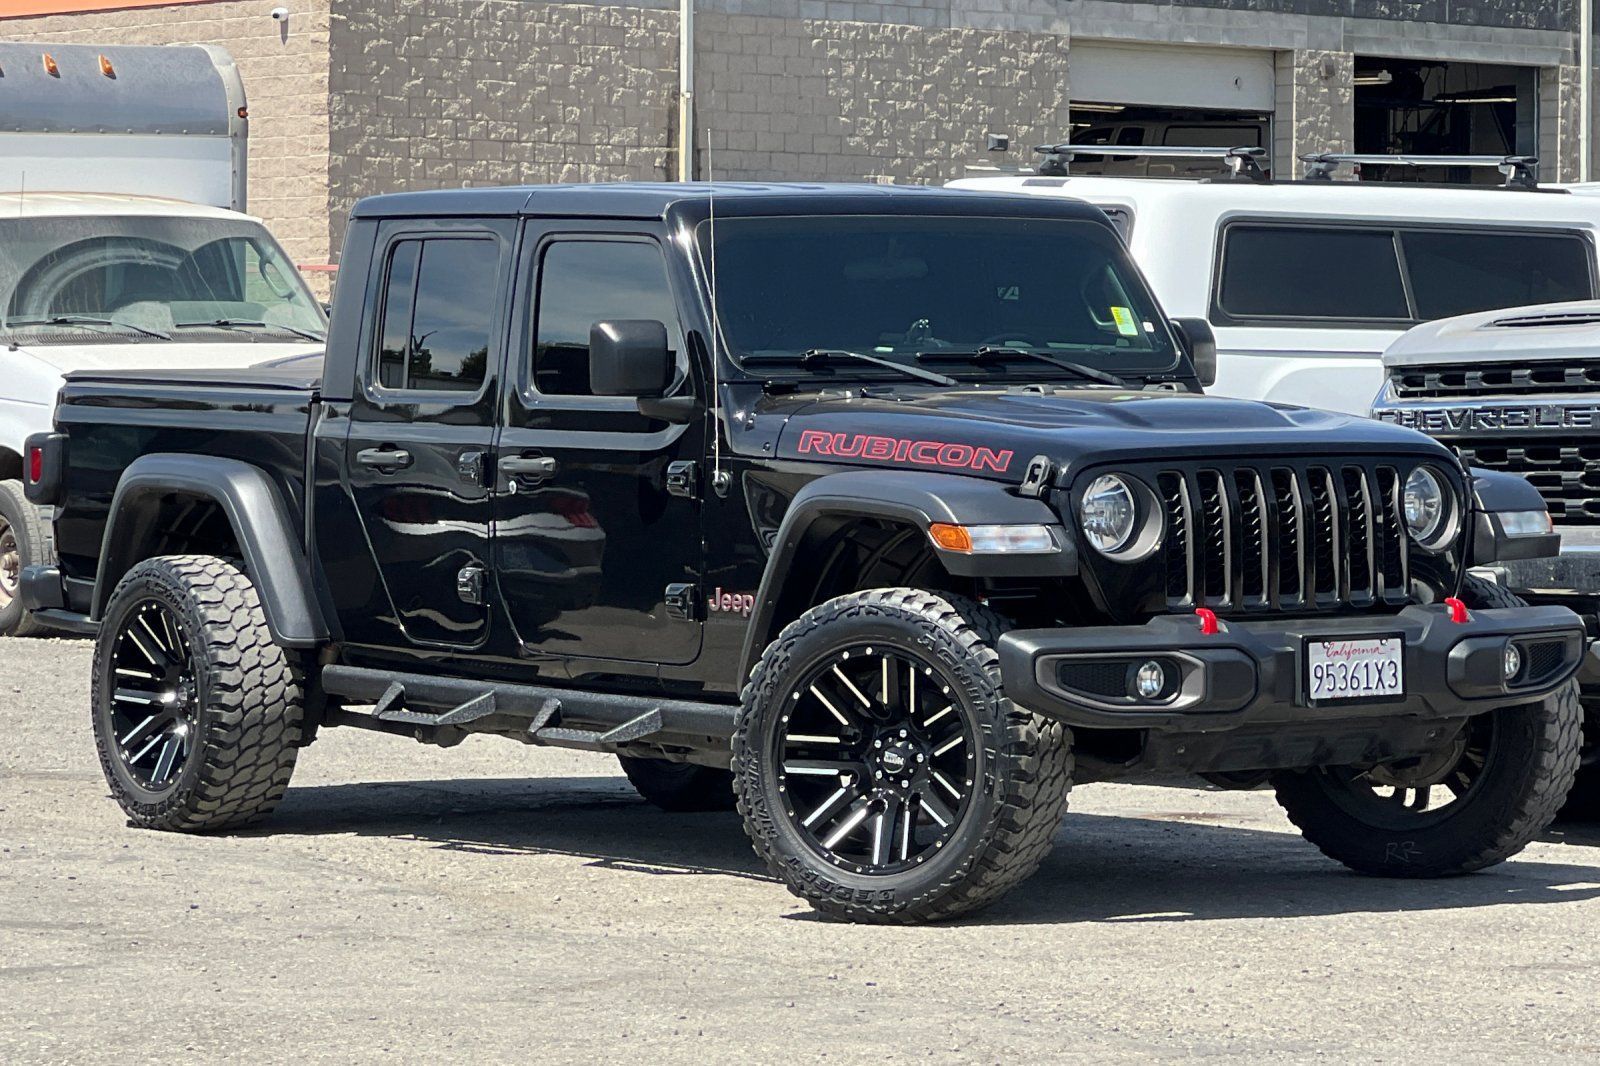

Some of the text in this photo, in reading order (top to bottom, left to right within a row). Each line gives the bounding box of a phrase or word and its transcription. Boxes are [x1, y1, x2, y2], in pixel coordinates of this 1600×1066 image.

[1372, 406, 1600, 431] CHEVROLE
[798, 429, 1014, 473] RUBICON
[709, 587, 754, 617] Jeep
[1325, 641, 1387, 660] California
[1313, 659, 1398, 693] 95361X3
